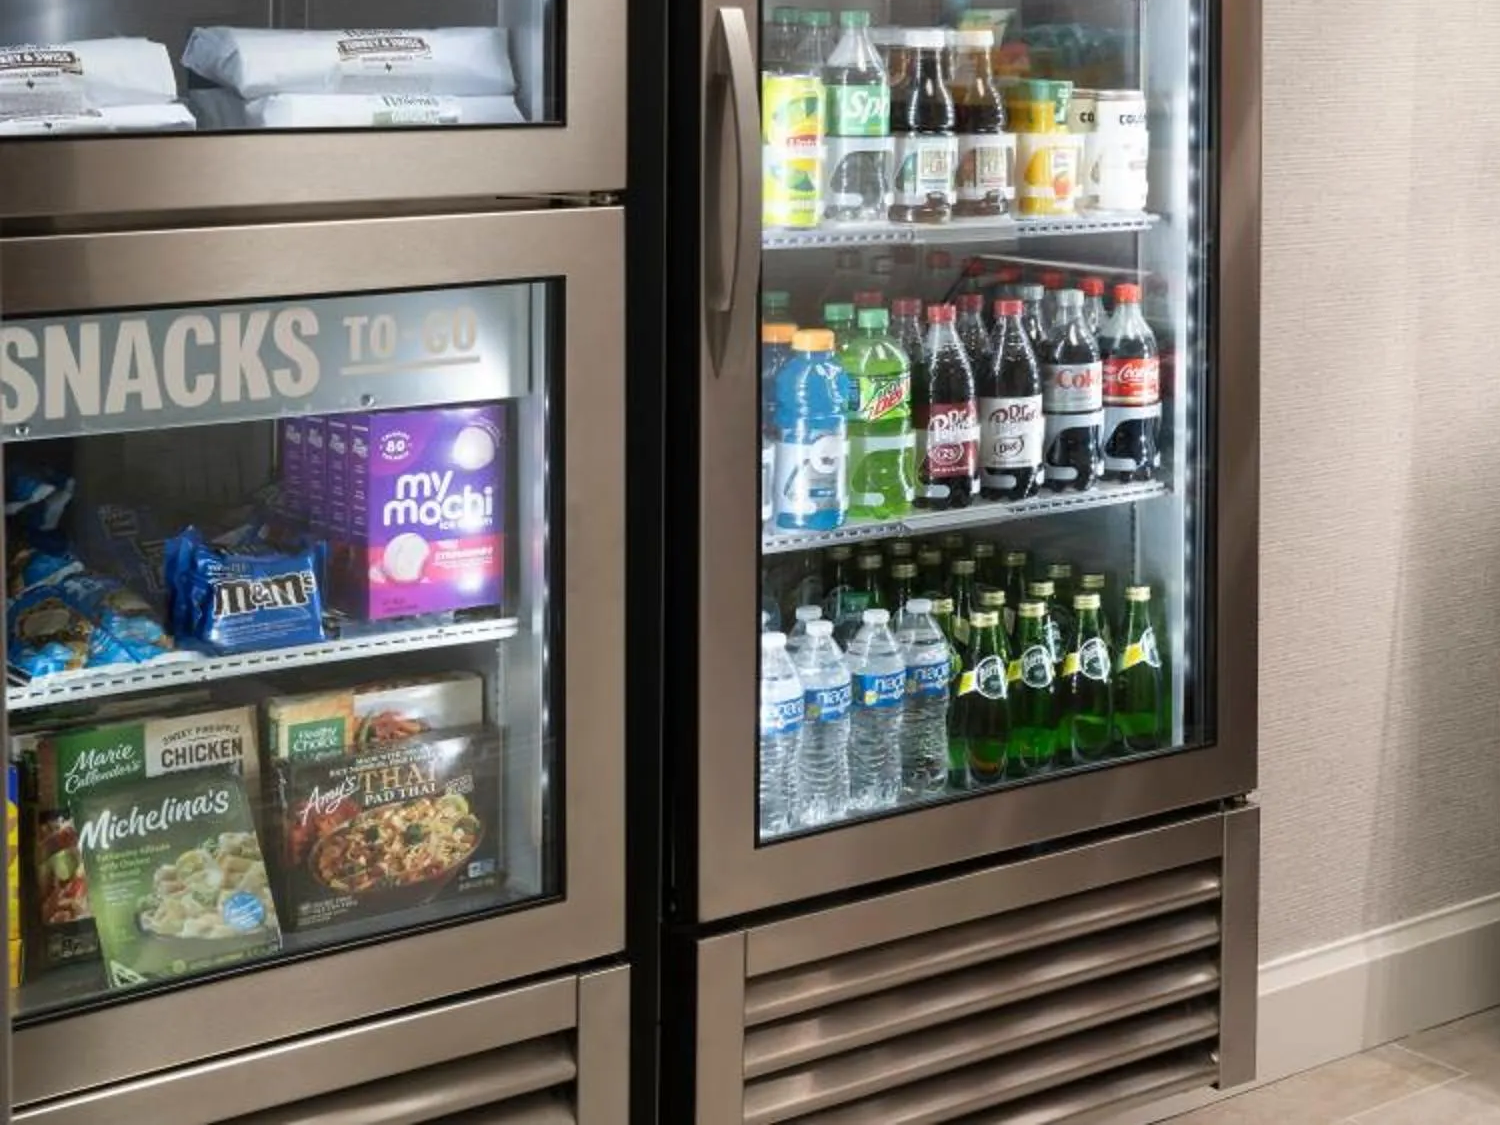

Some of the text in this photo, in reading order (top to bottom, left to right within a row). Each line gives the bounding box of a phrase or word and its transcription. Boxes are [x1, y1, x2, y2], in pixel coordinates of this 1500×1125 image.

[0, 307, 321, 427] SNACKS
[386, 439, 405, 454] 80
[396, 470, 454, 503] my
[383, 484, 494, 527] mochi
[65, 743, 135, 776] Marie
[161, 736, 243, 769] CHICKEN
[358, 758, 437, 794] THAI
[301, 776, 359, 827] Amy's
[364, 782, 437, 807] PAD THAI
[78, 789, 231, 852] Michelina's
